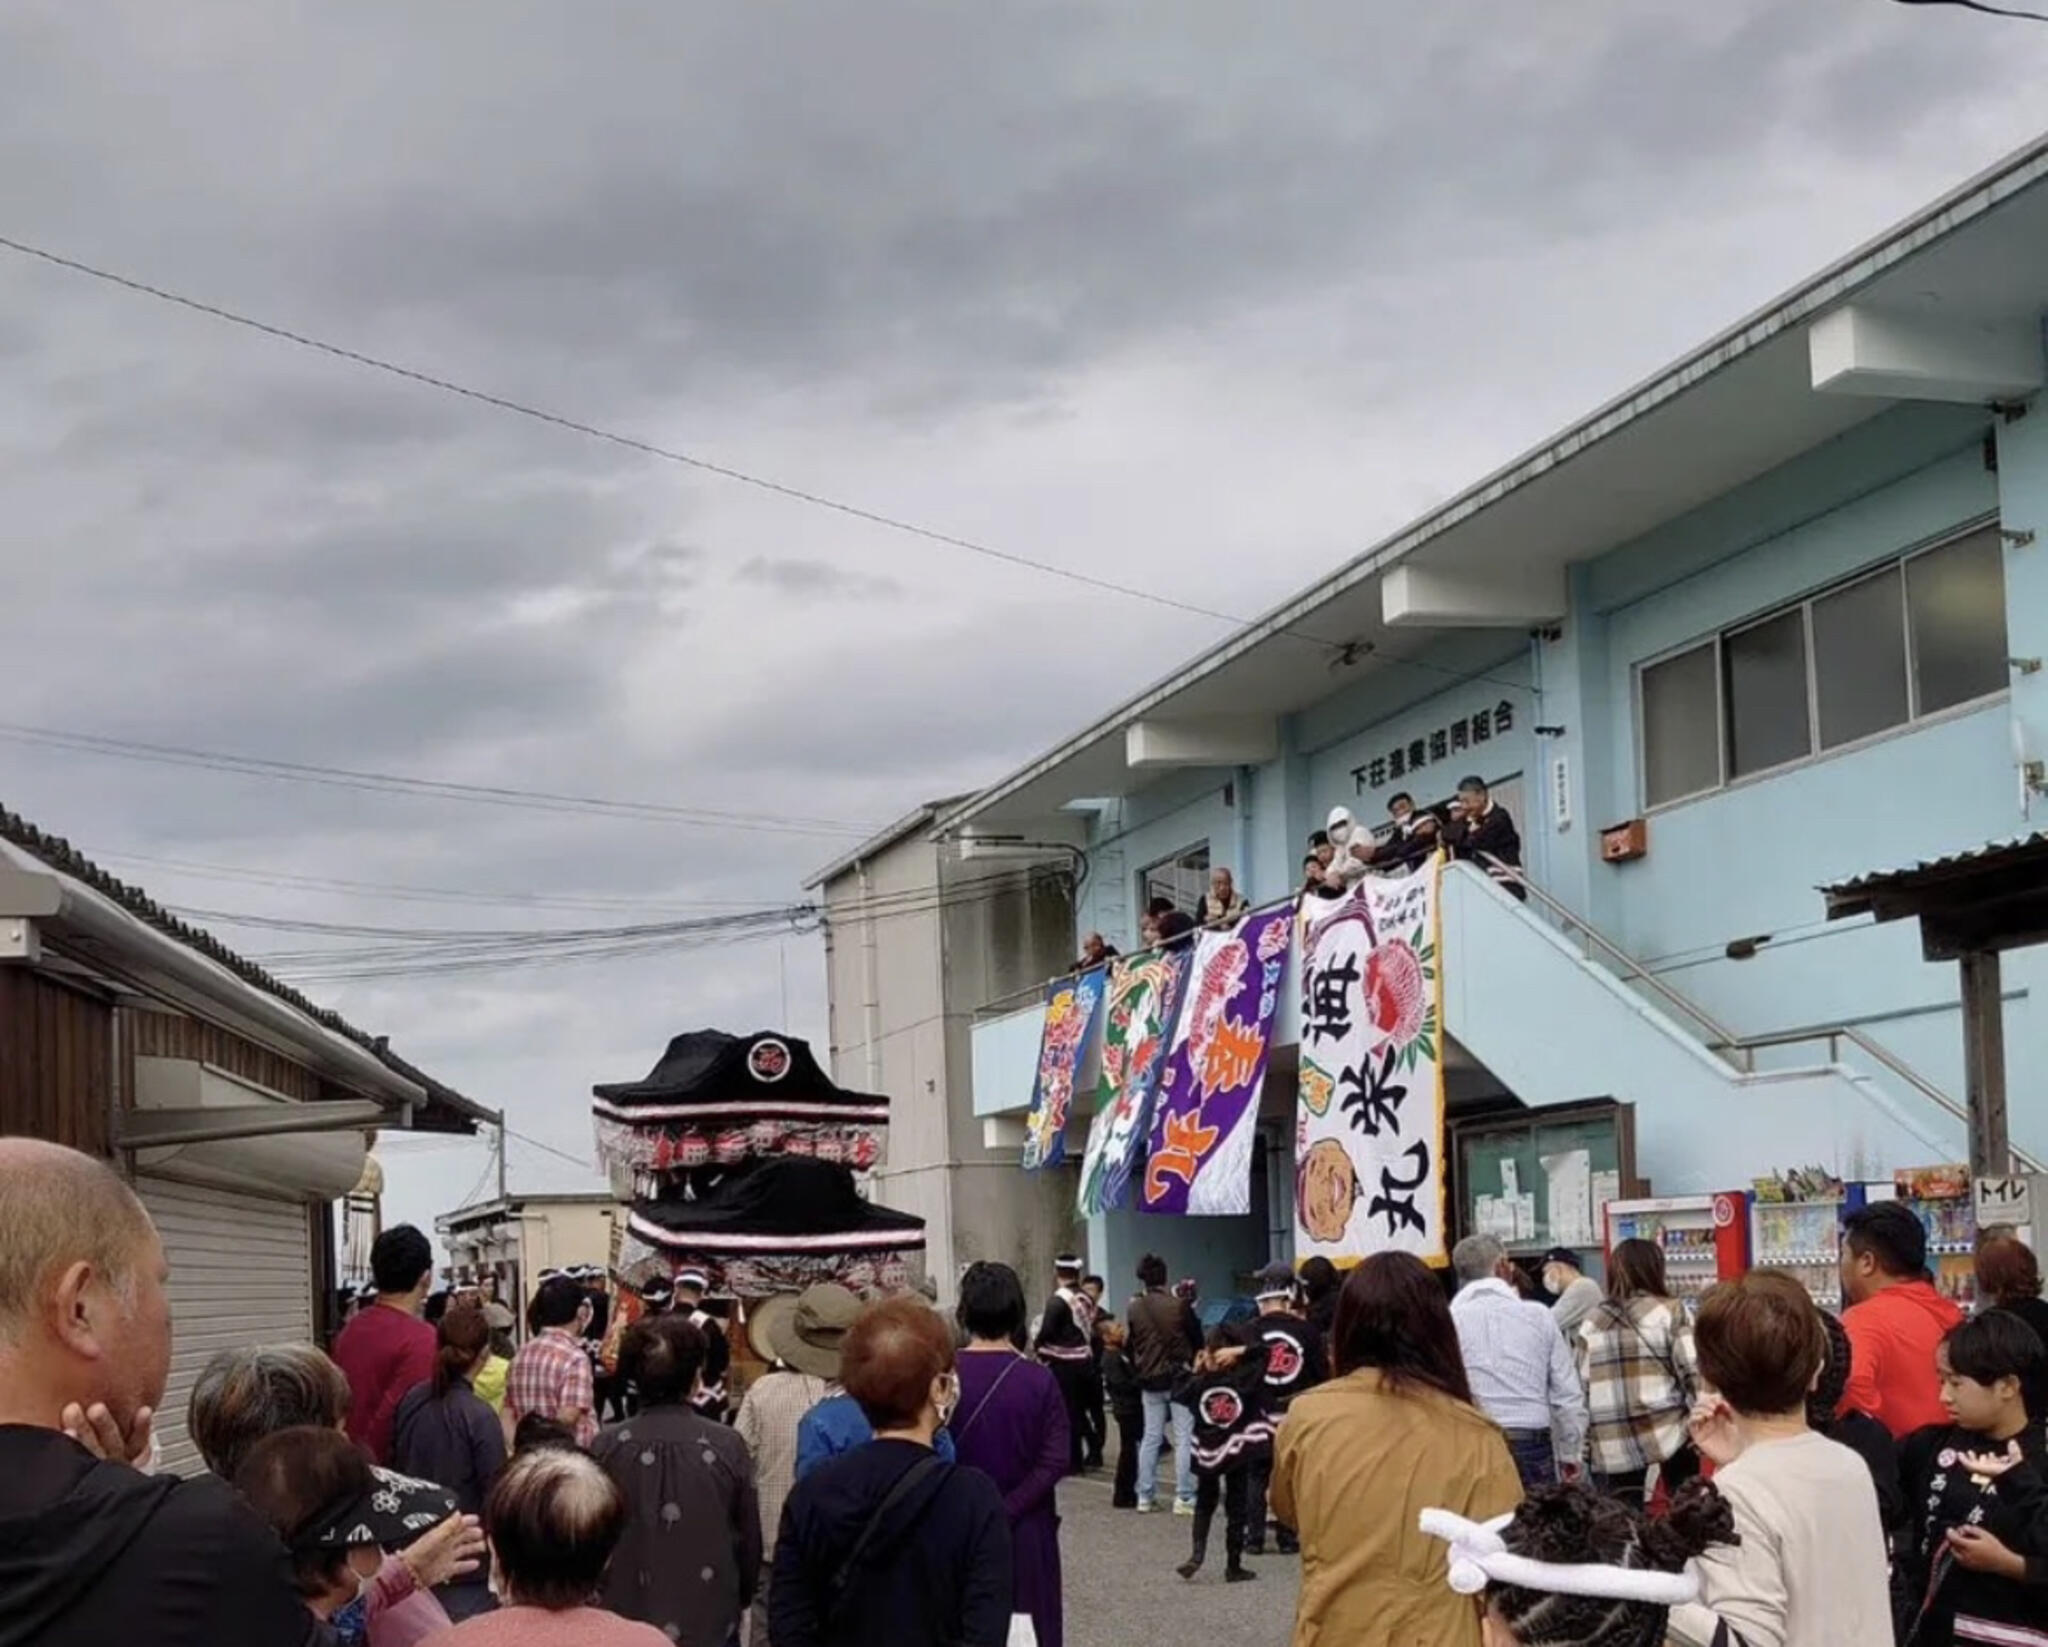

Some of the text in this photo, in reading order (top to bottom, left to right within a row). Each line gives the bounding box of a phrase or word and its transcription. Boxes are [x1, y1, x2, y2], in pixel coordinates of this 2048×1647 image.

[1301, 951, 1430, 1238] 海栄丸
[1980, 1180, 2026, 1204] トイレ
